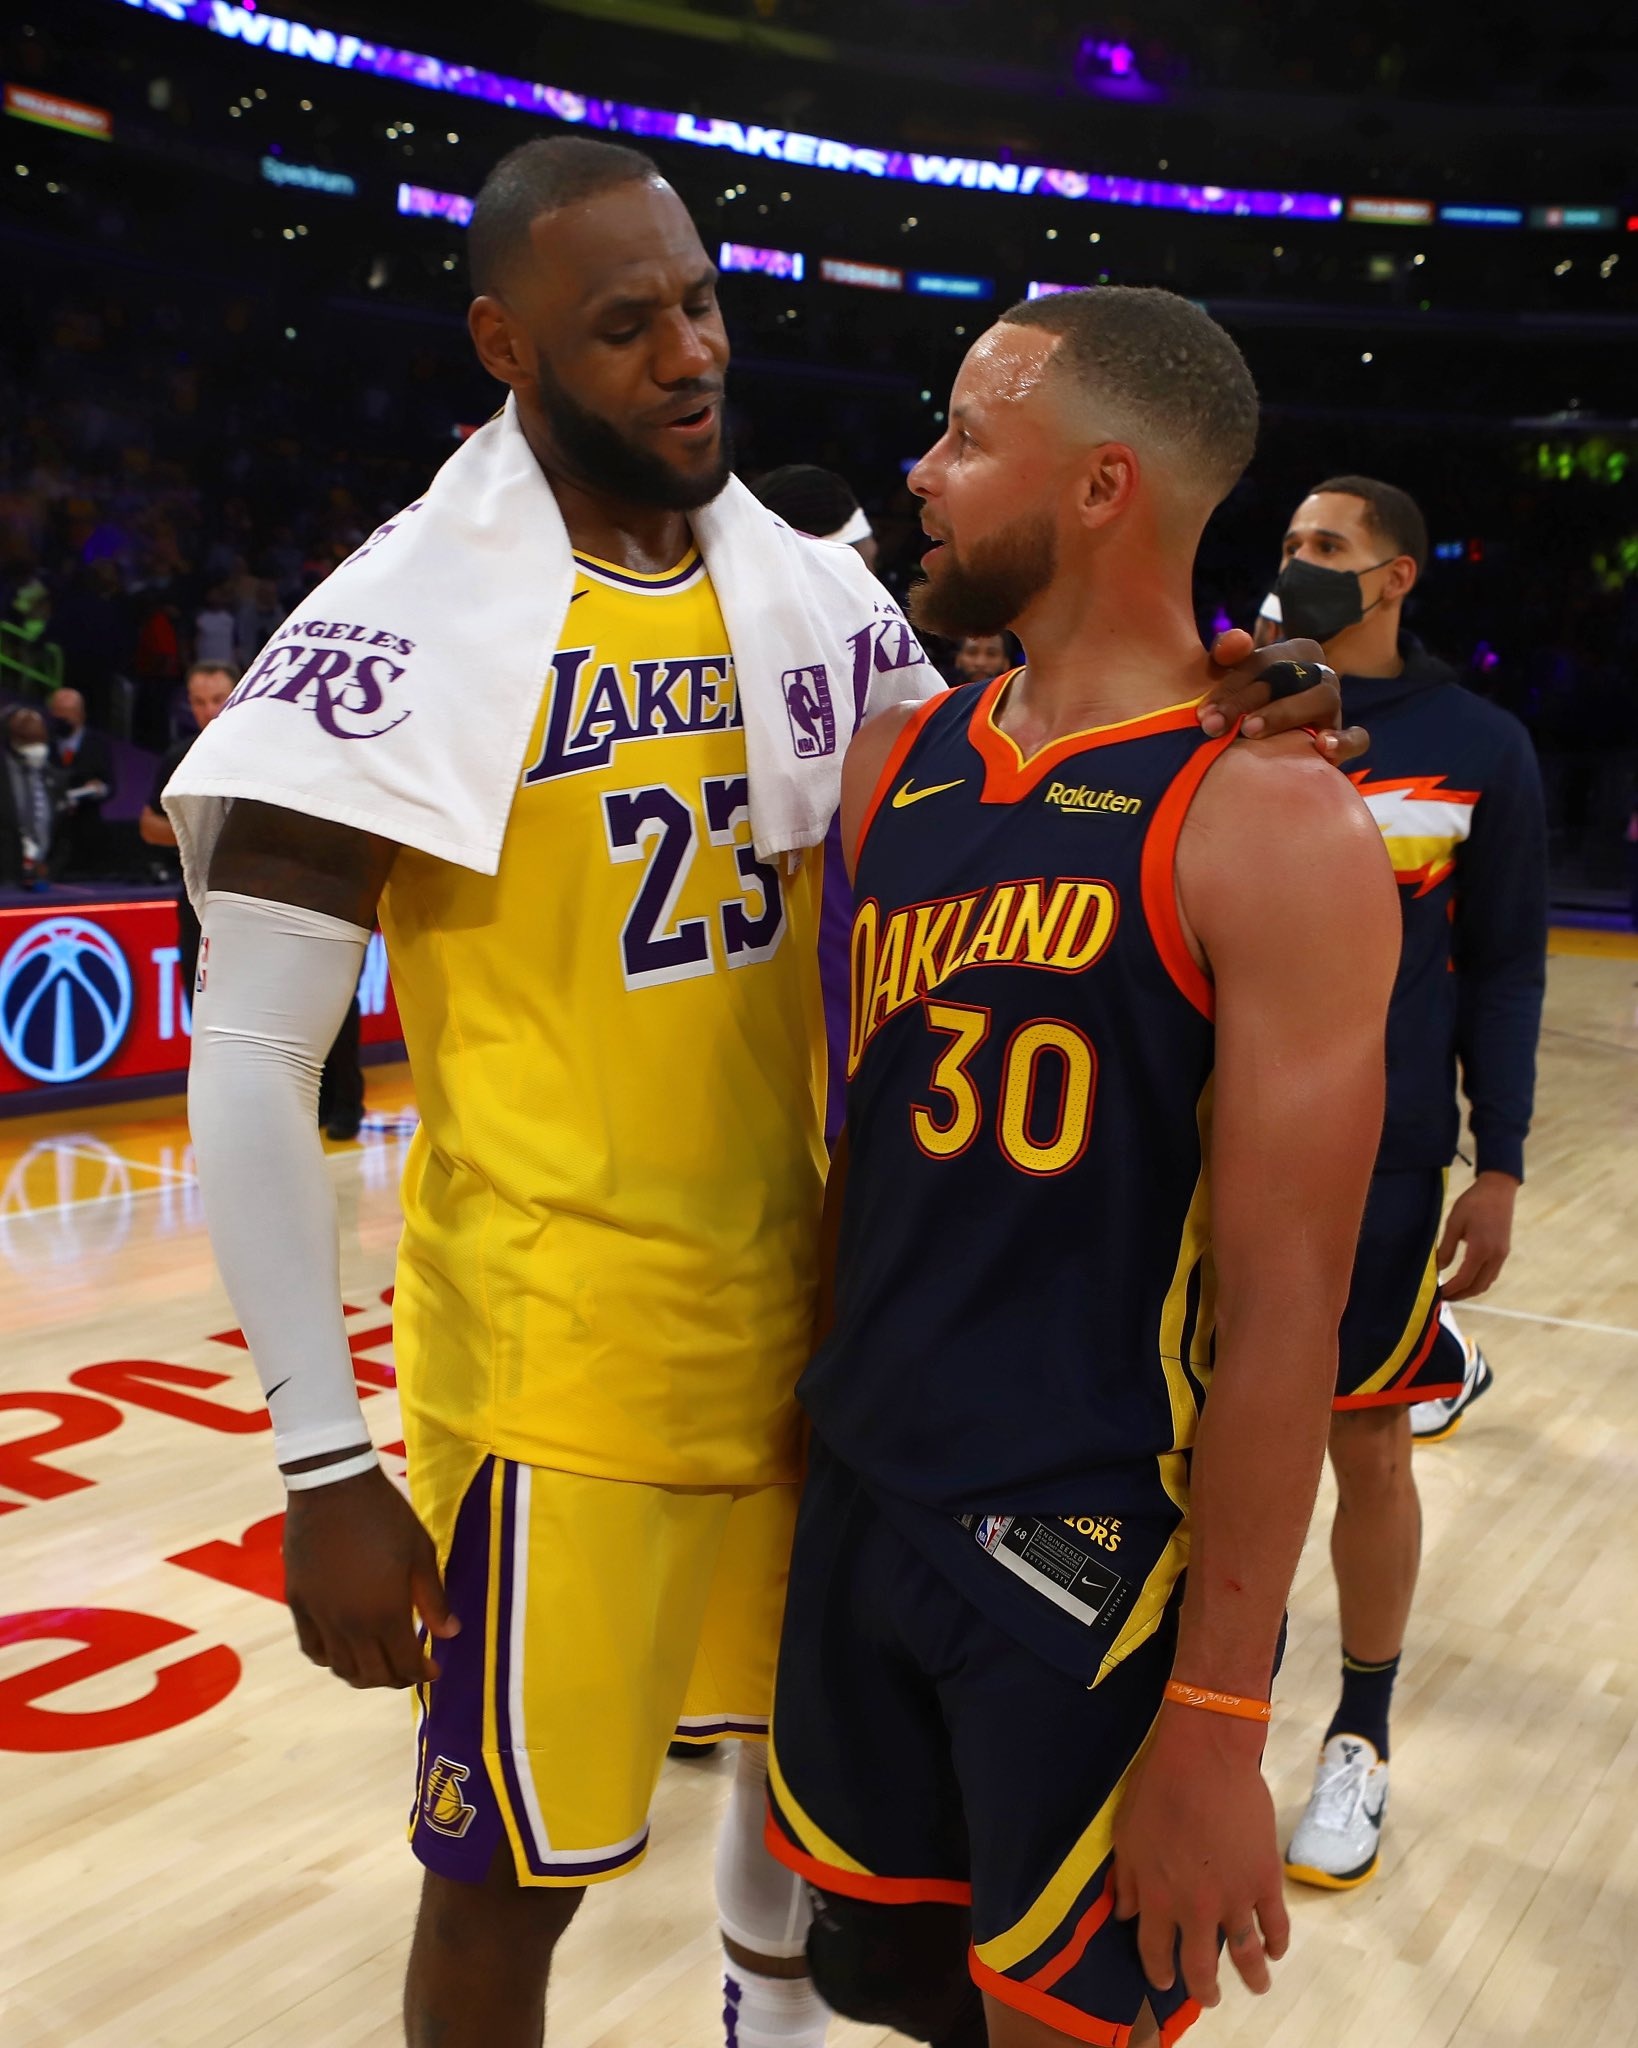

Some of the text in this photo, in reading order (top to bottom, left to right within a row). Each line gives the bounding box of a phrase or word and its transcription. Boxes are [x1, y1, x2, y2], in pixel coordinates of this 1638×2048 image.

[676, 112, 1045, 195] LAKERS WIN!
[213, 645, 413, 740] ERS
[1044, 782, 1142, 815] Rakuten
[600, 773, 788, 993] 23
[847, 877, 1120, 1082] OAKLAND
[910, 998, 1098, 1177] 30
[1013, 1527, 1027, 1540] 48
[1038, 1528, 1084, 1563] ENGINEERED
[1057, 1515, 1122, 1552] IORS
